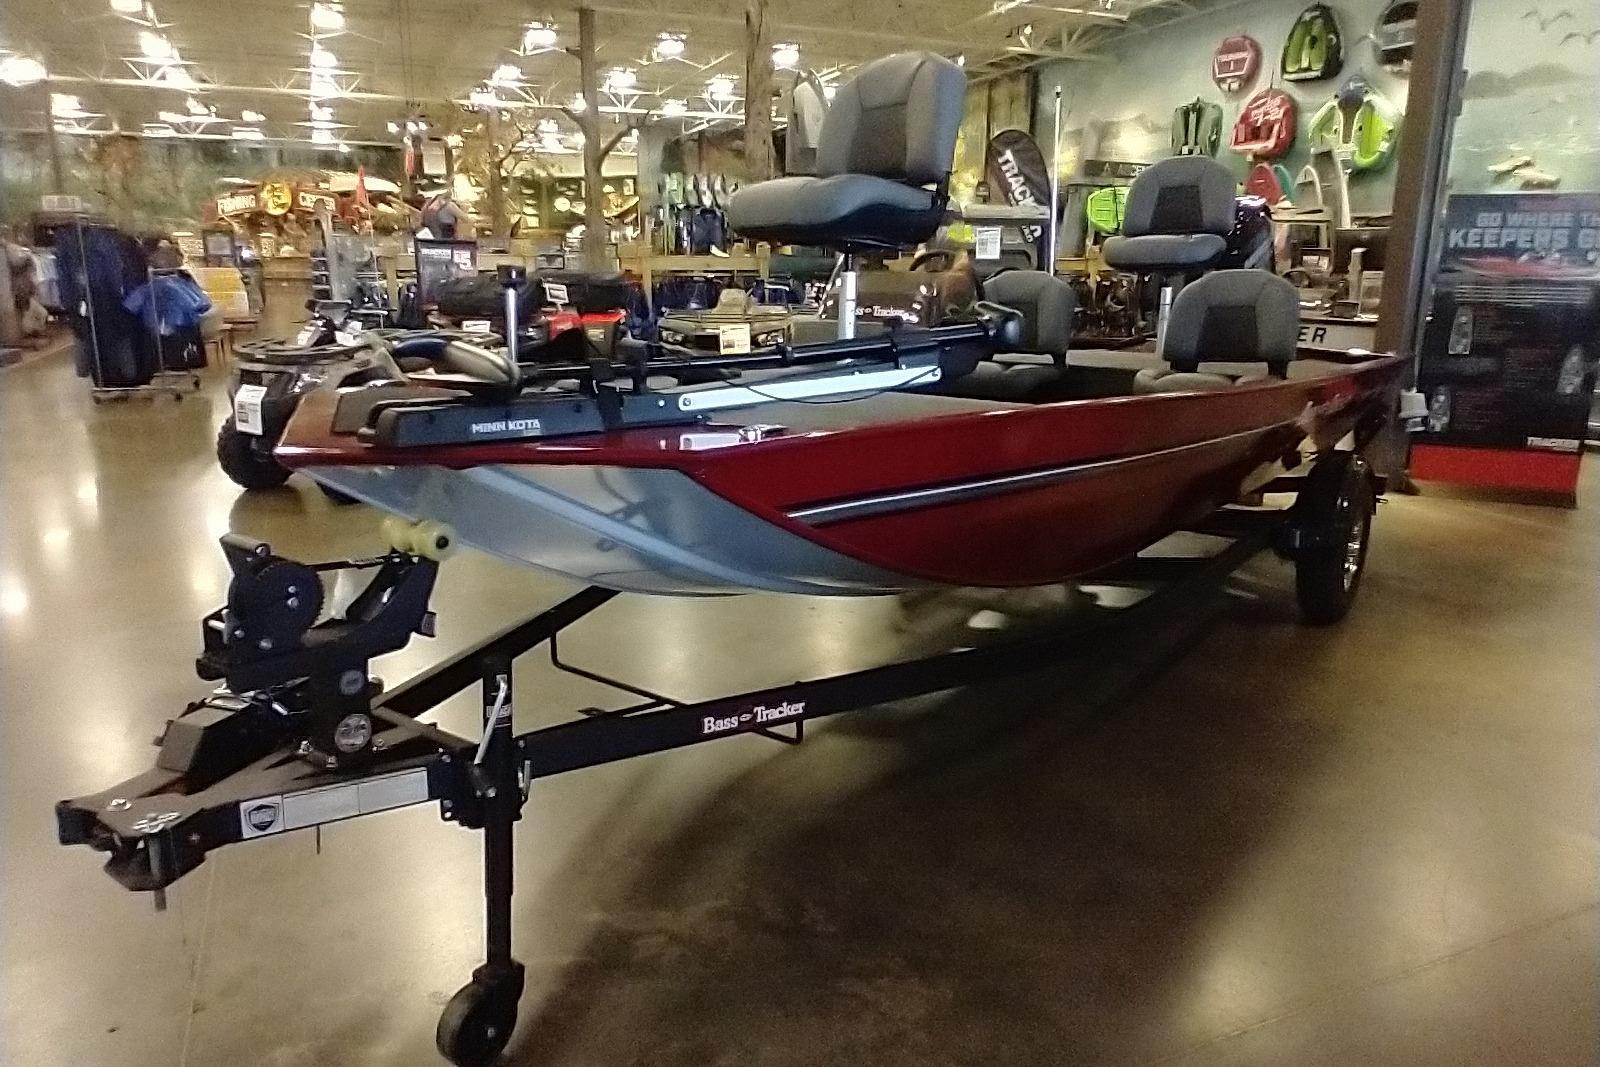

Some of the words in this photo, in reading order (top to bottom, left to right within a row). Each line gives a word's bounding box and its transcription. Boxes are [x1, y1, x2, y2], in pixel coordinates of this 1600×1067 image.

[1507, 212, 1574, 227] WHERE
[1449, 228, 1569, 249] KEEPERS
[472, 421, 506, 434] MINN
[508, 419, 541, 431] KOTA
[703, 716, 739, 734] Bass
[753, 702, 806, 723] Tracker
